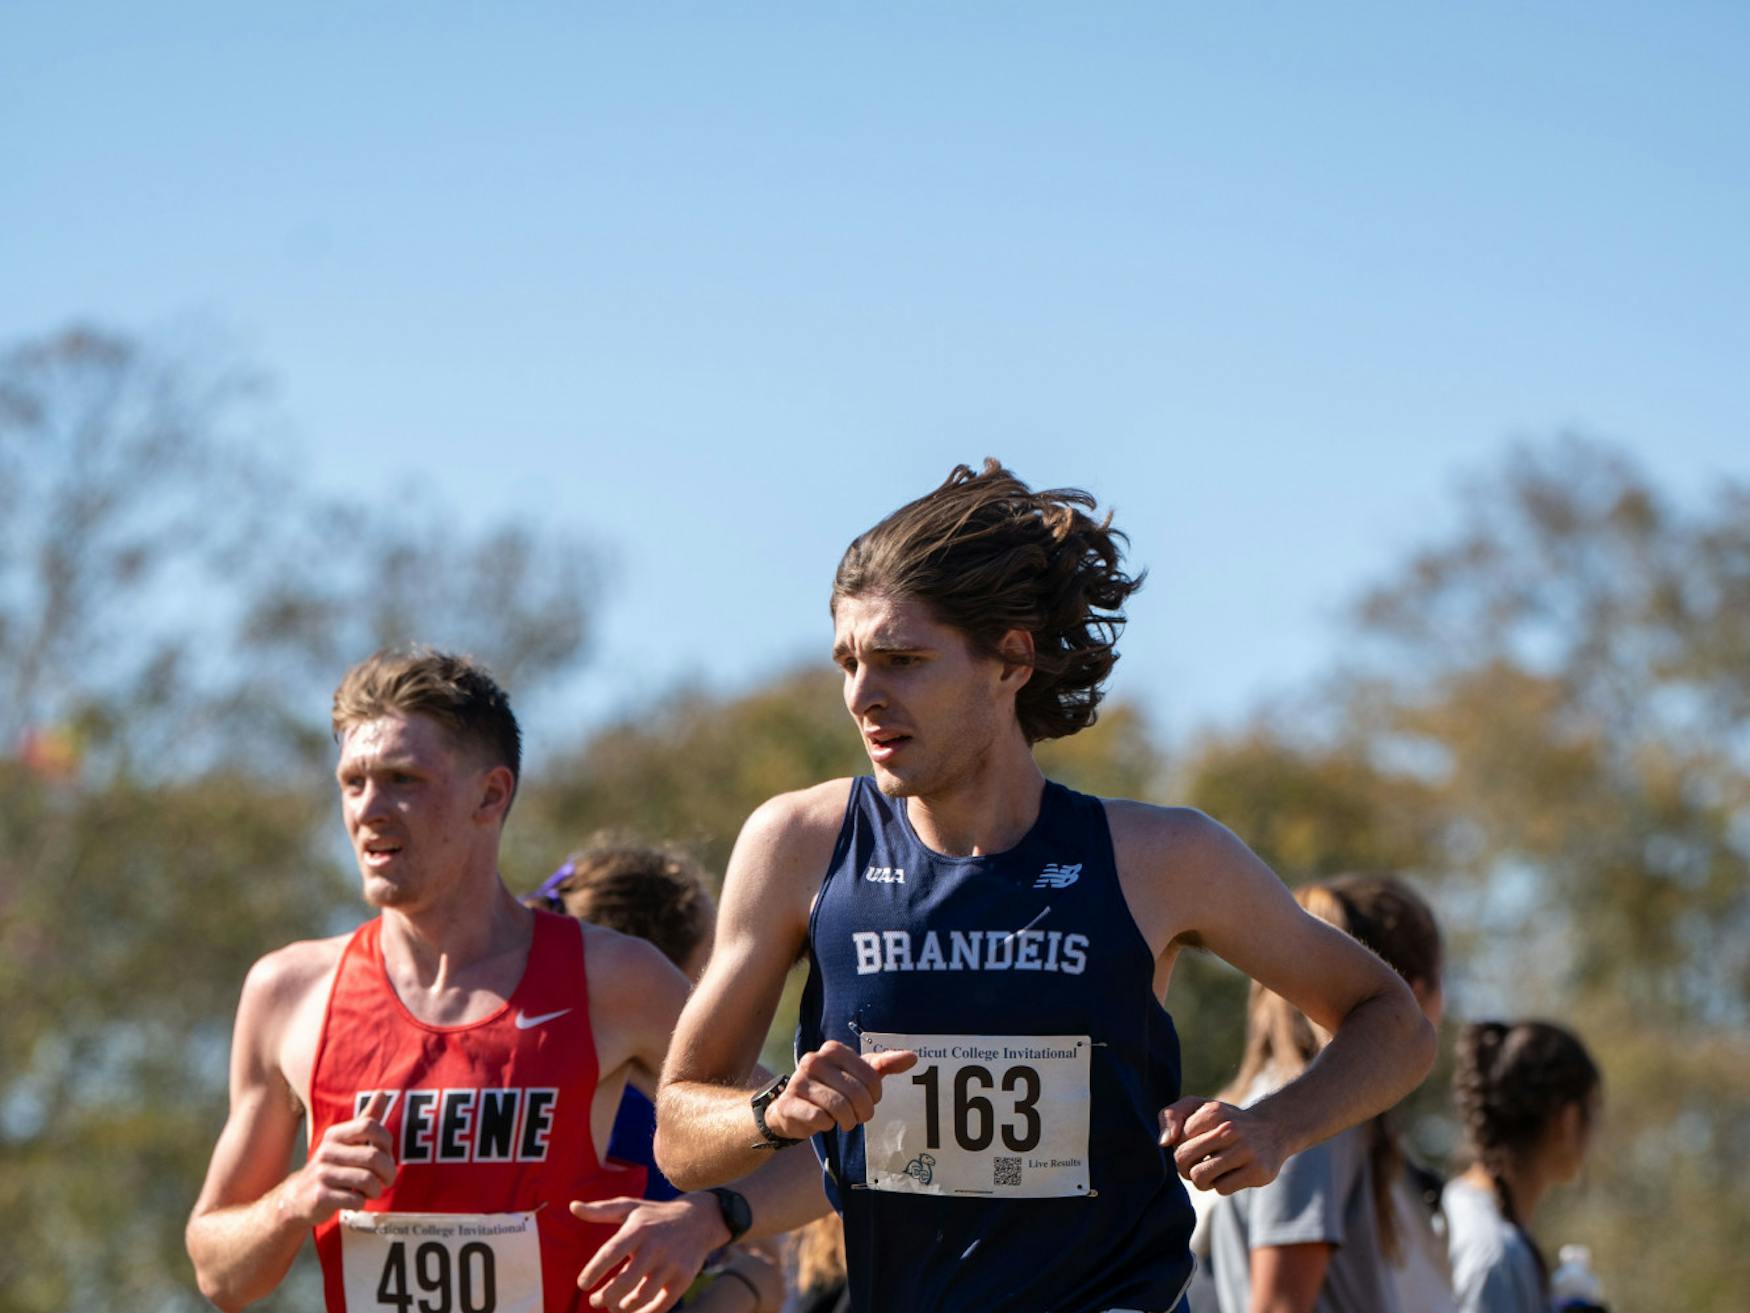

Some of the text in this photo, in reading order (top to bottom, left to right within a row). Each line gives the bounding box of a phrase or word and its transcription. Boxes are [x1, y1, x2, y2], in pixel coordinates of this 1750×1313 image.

[866, 867, 905, 884] UAA
[852, 930, 1090, 975] BRANDEIS
[872, 1043, 1077, 1061] Cticut College Invitational
[912, 1065, 1041, 1152] 163
[1028, 1157, 1082, 1168] Live Results
[412, 1223, 455, 1237] College
[458, 1223, 526, 1236] Invitational
